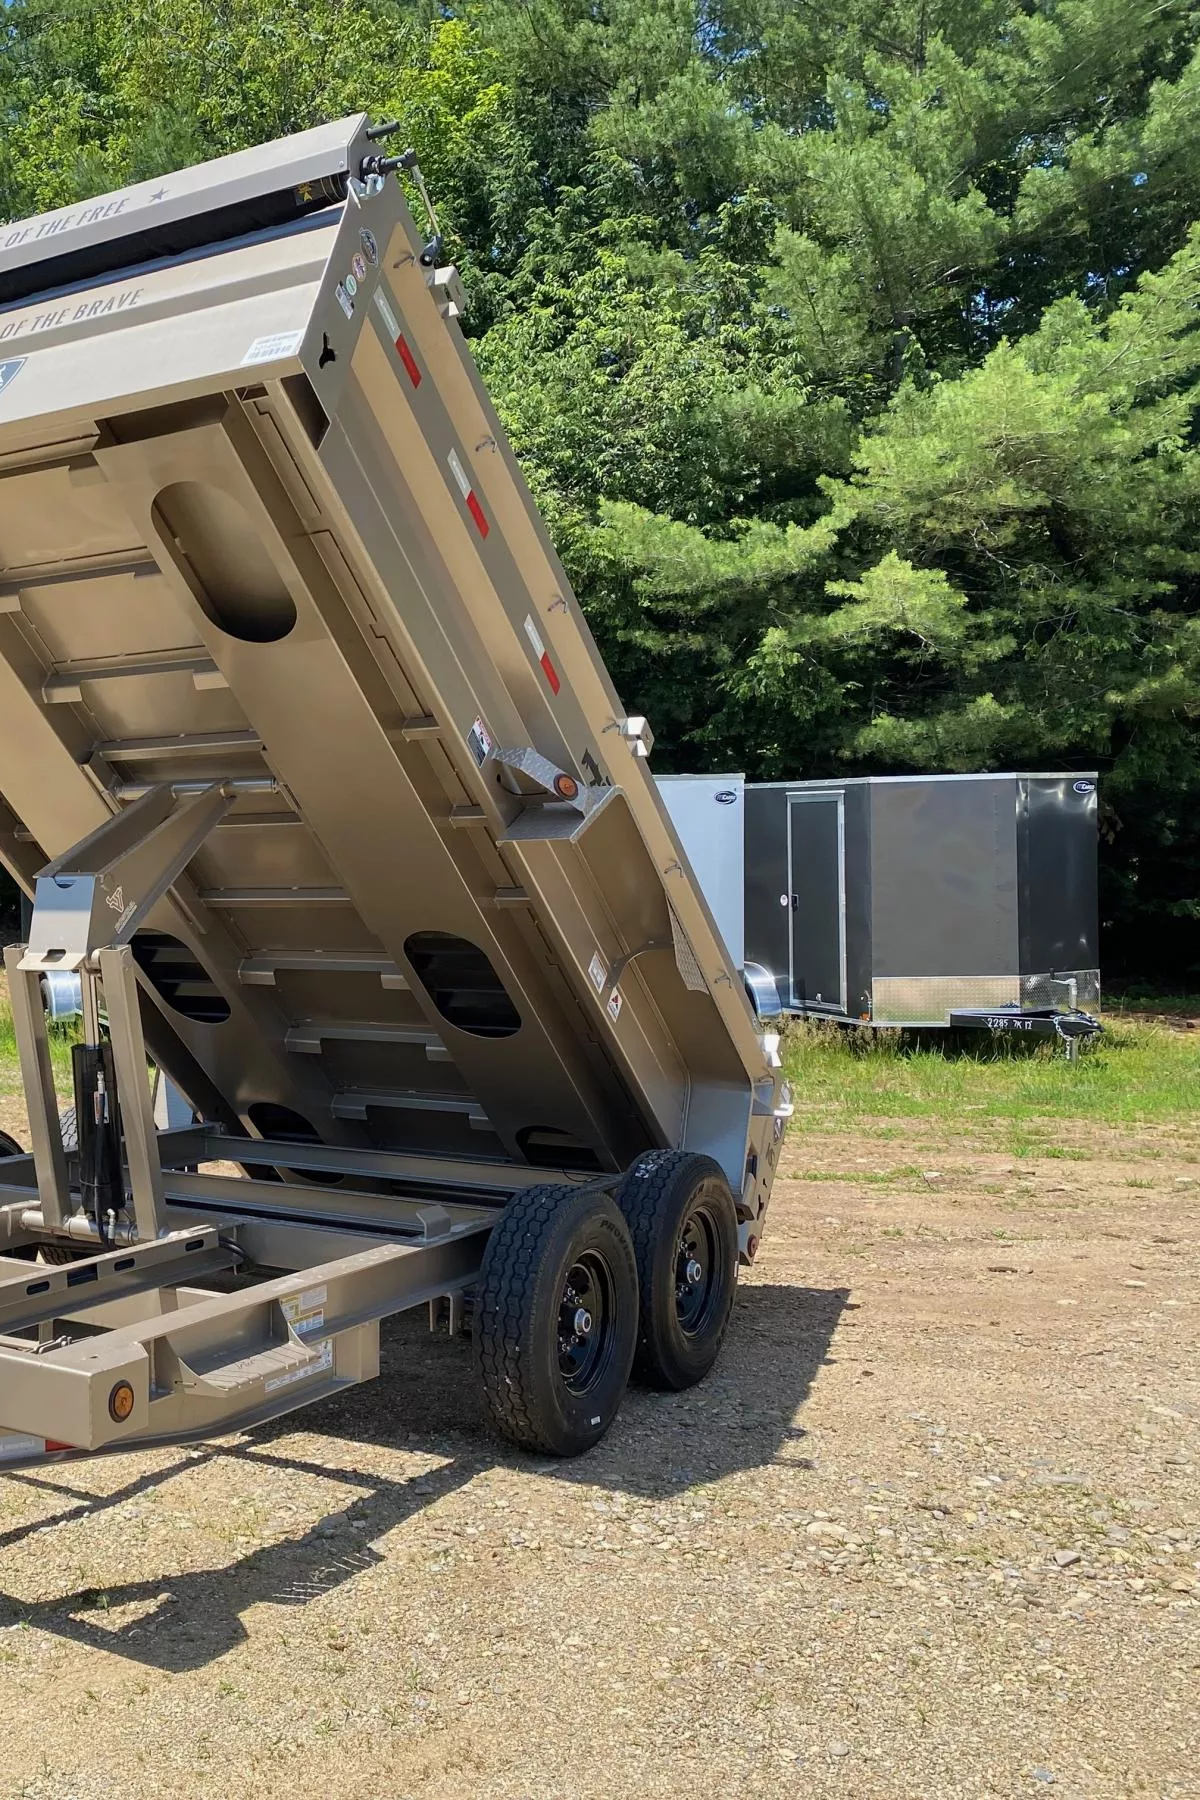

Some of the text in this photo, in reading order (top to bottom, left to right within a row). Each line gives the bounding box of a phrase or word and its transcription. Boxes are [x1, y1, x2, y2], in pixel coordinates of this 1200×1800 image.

[4, 227, 33, 247] OF
[35, 214, 76, 239] THE
[76, 197, 130, 227] FREE
[0, 319, 28, 339] OF
[30, 308, 67, 333] THE
[72, 288, 144, 321] BRAVE
